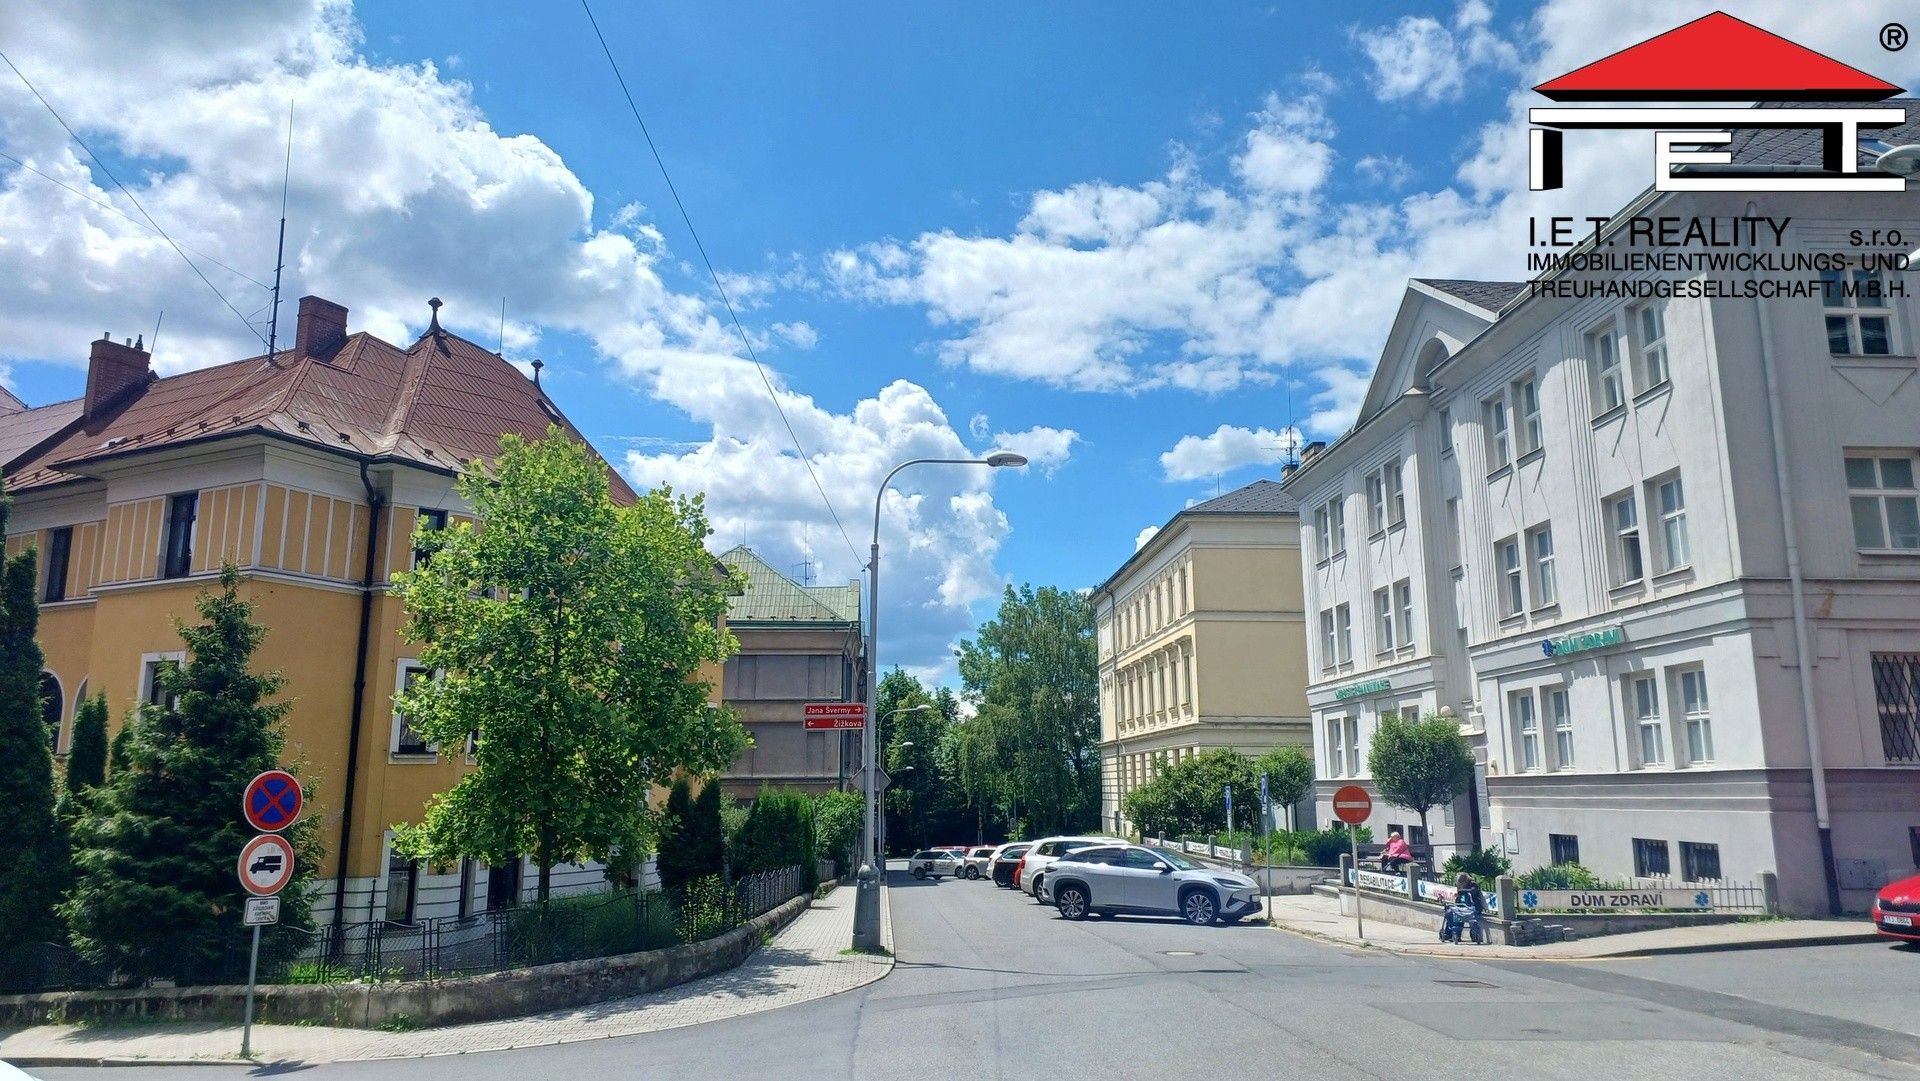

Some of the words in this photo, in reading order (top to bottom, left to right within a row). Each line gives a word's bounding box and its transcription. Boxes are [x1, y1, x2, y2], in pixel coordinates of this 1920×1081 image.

[825, 706, 851, 715] Švermy
[833, 719, 862, 728] Žižkova
[1570, 891, 1605, 907] DŮM
[1610, 891, 1664, 906] ZDRAVÍ
